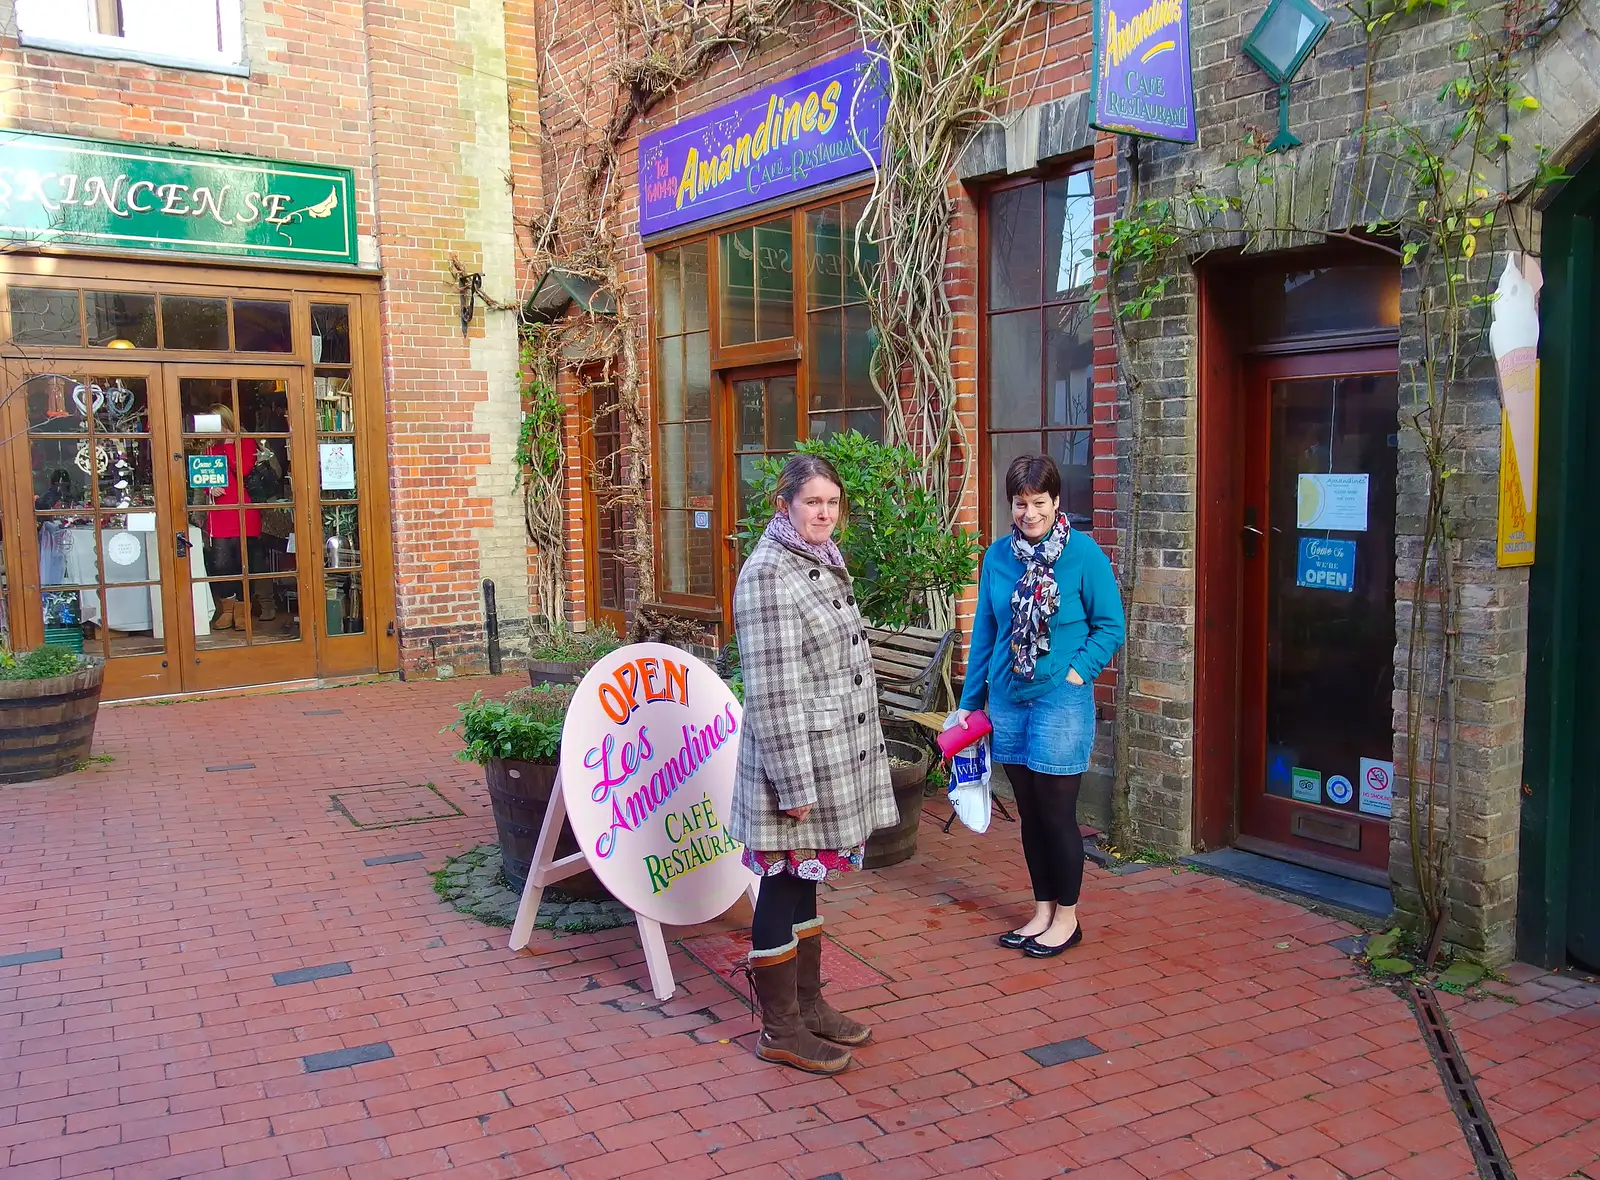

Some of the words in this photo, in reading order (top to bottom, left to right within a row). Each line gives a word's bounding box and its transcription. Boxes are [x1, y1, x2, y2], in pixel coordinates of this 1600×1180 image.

[1104, 0, 1182, 78] Amandines
[1109, 92, 1188, 126] RESTAURANT
[675, 80, 843, 211] Amandines
[193, 474, 225, 484] OPEN
[1305, 569, 1347, 587] OPEN
[1306, 540, 1332, 560] Come
[598, 657, 690, 726] OPEN
[583, 725, 655, 804] Les
[595, 701, 740, 860] Amandines
[663, 792, 721, 845] CAFÉ
[643, 825, 742, 895] RESTAURA
